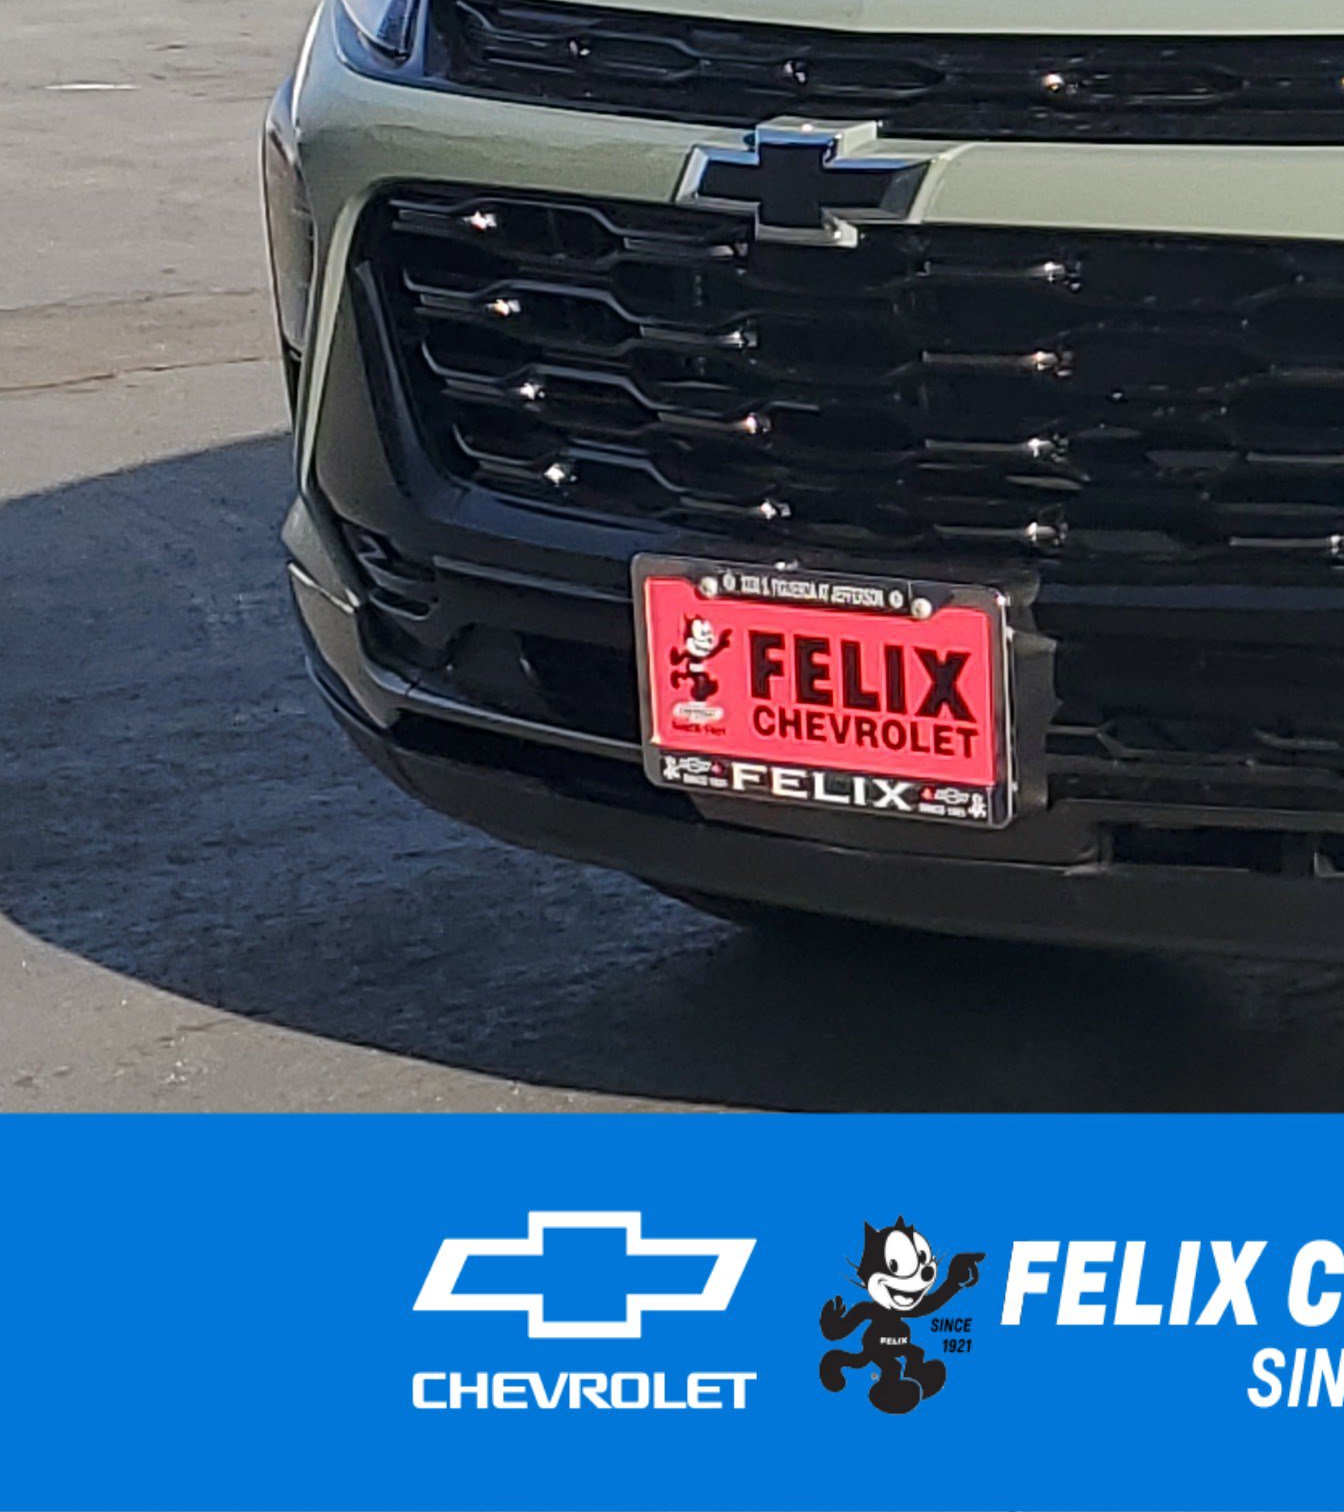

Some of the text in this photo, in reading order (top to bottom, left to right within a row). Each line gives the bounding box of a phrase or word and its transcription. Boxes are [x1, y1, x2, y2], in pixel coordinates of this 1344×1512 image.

[747, 628, 978, 723] FELIX
[752, 704, 980, 758] CHEVROLET
[730, 761, 914, 812] FELIX
